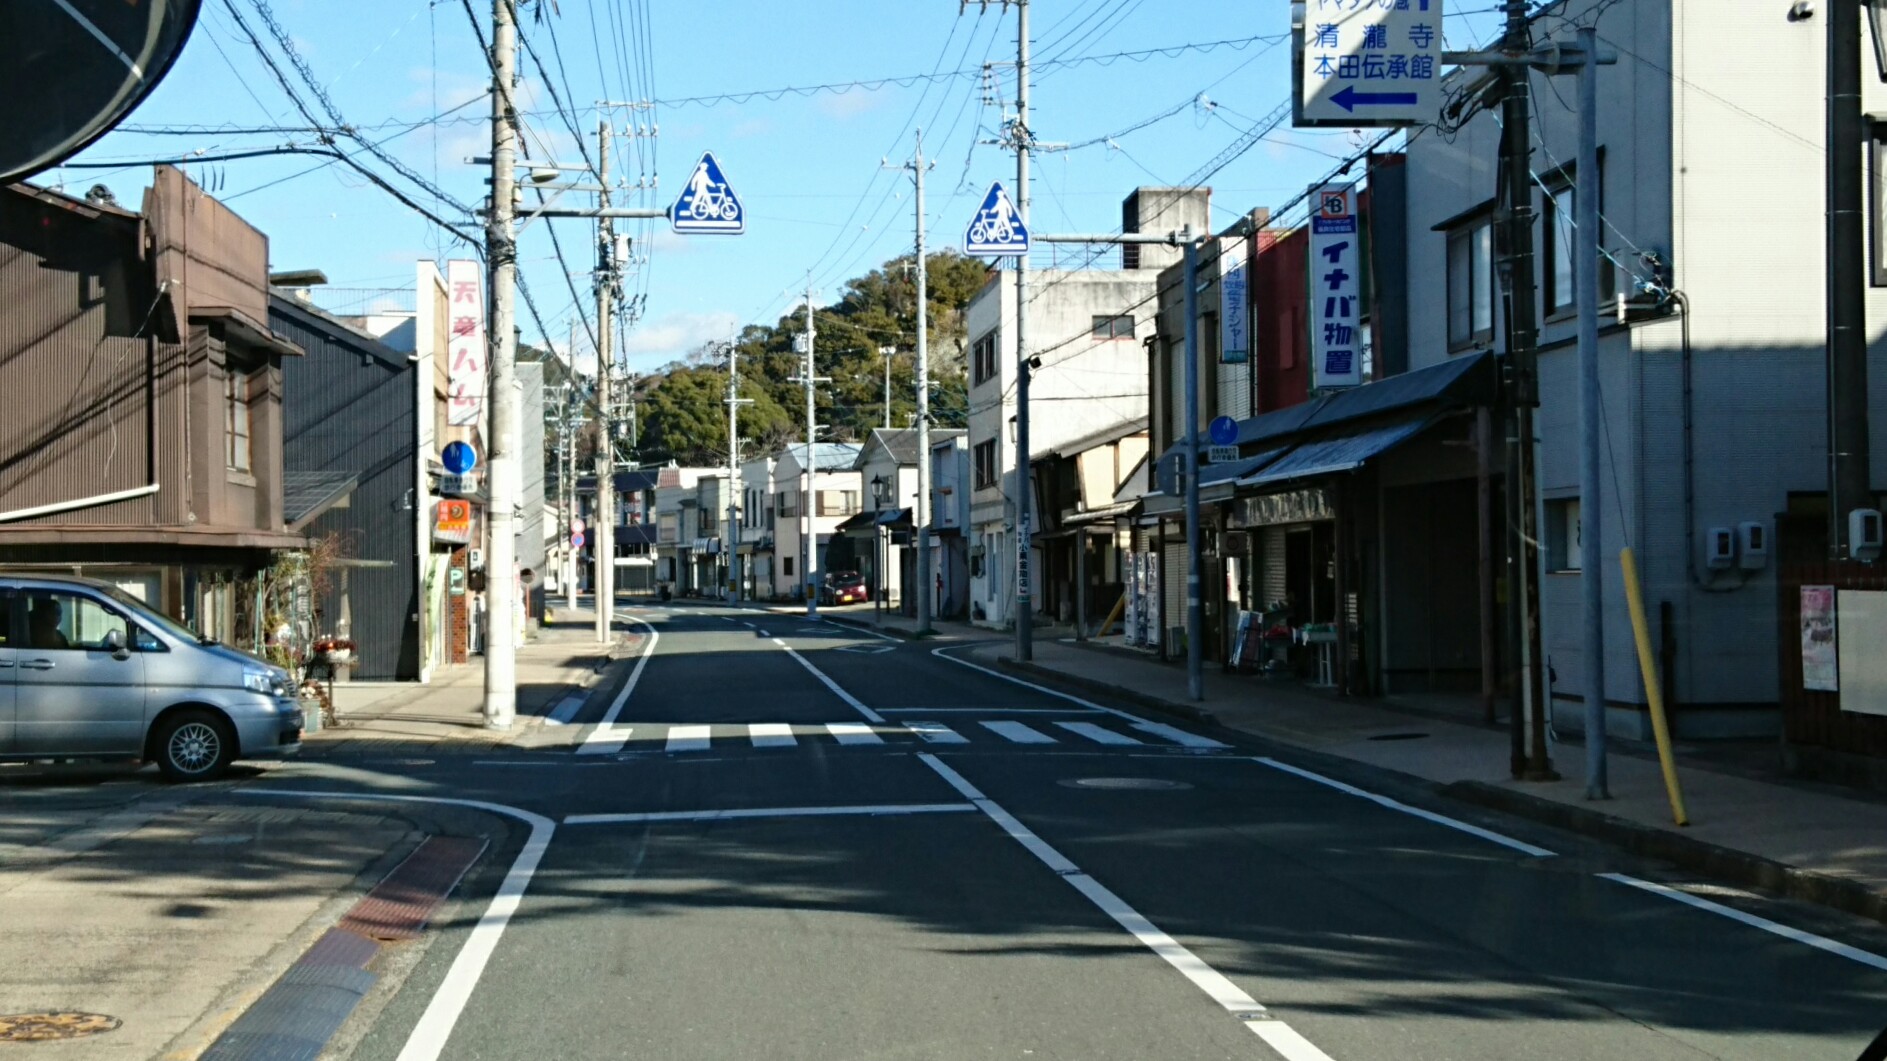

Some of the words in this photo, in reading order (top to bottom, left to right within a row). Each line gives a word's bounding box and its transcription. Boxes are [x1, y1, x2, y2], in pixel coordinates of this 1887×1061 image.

[1314, 23, 1434, 49] 清瀧寺
[1313, 54, 1434, 80] 本田伝承館
[1322, 240, 1357, 375] イナバ物置
[452, 280, 478, 407] 天竜ハム
[450, 569, 464, 585] P
